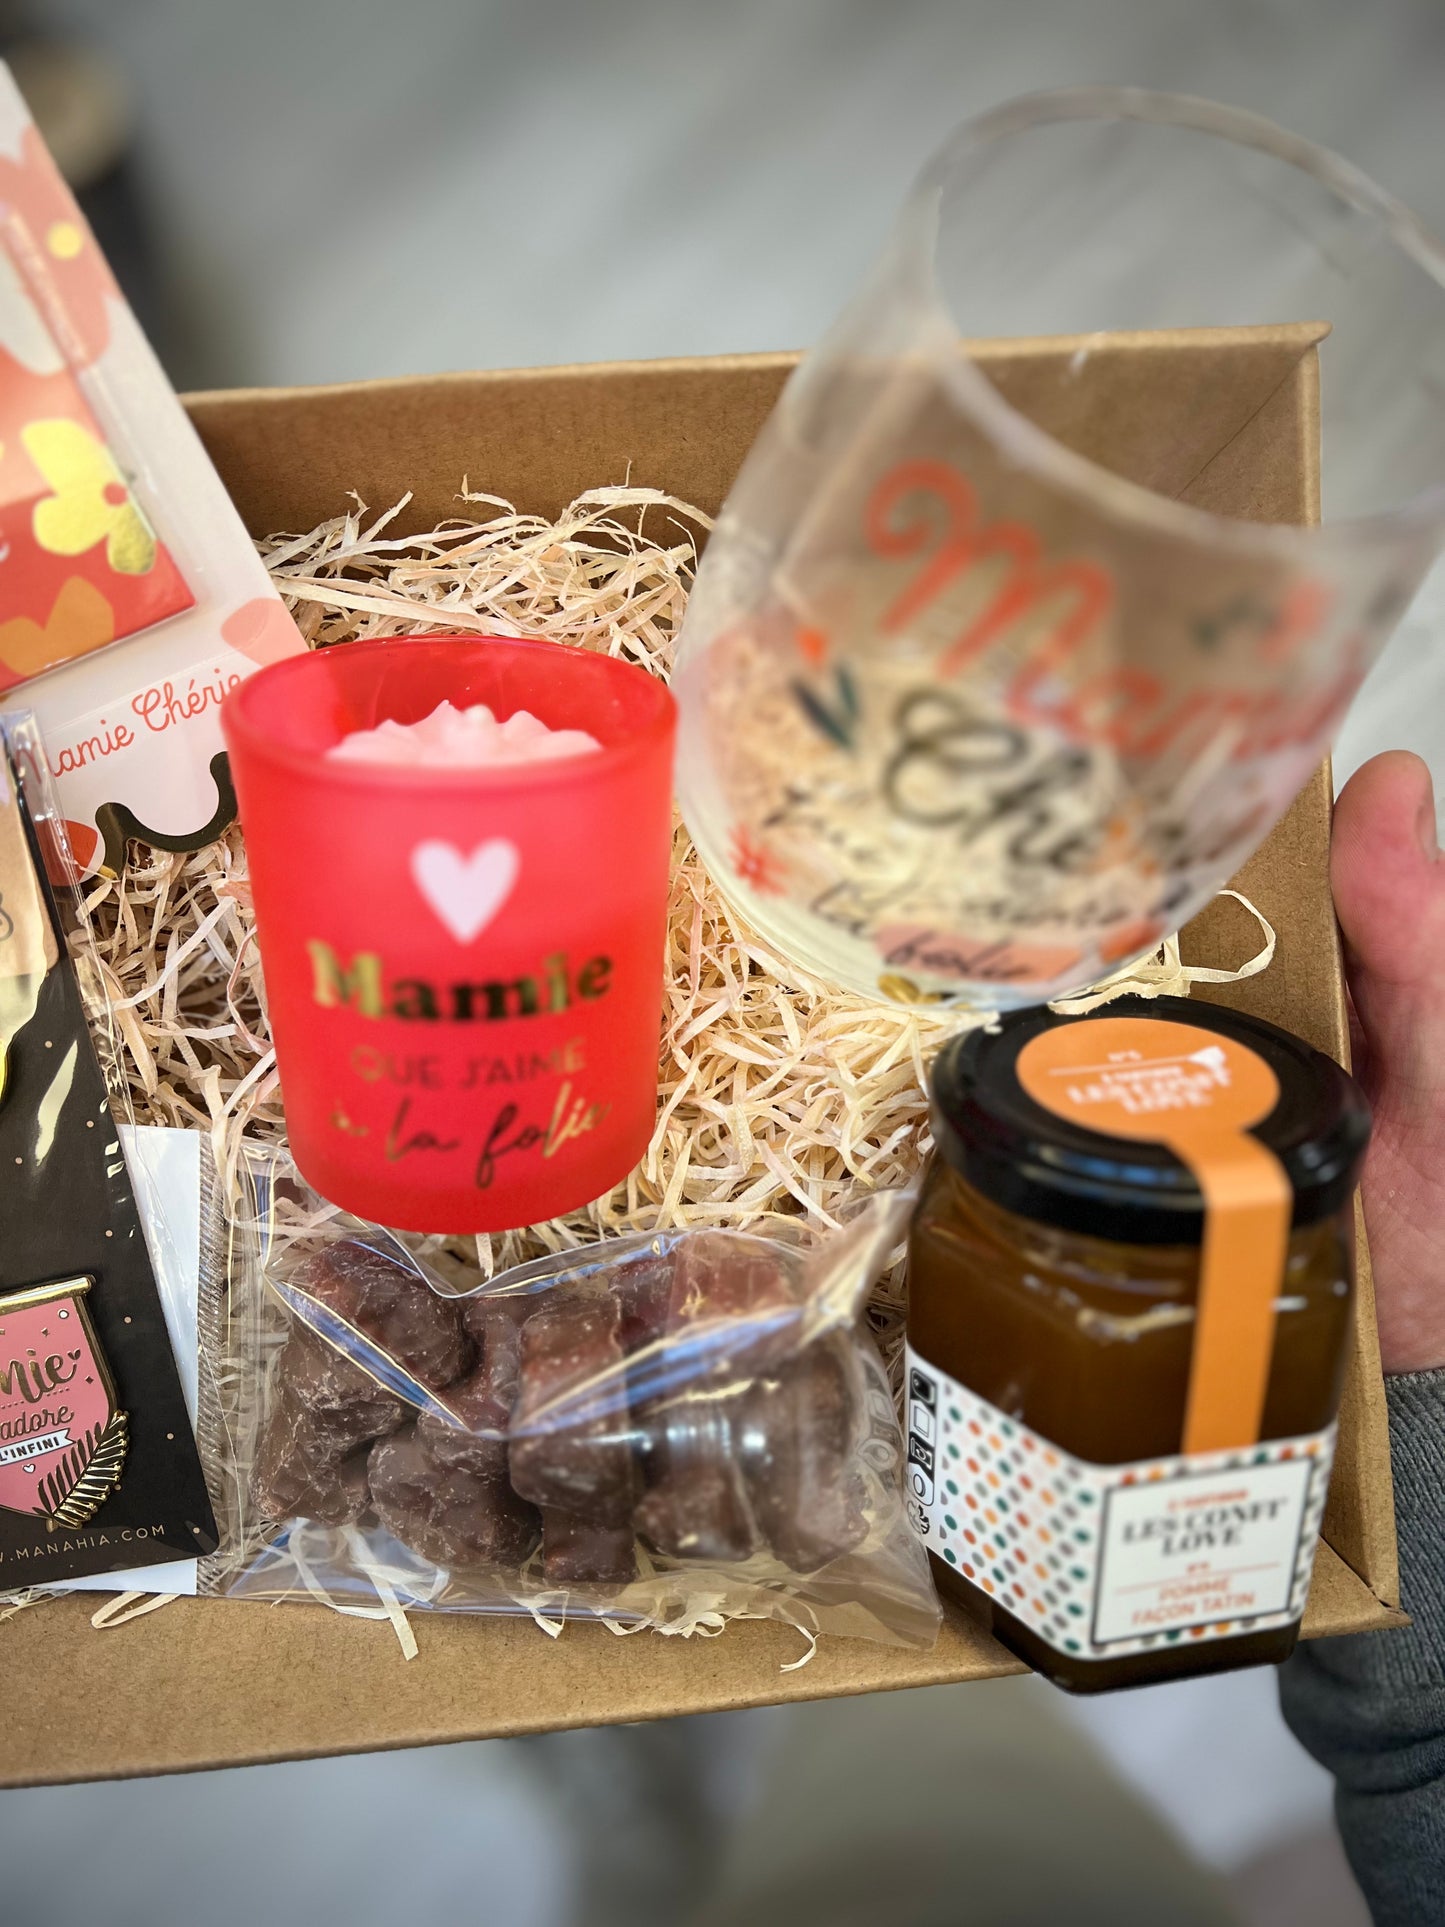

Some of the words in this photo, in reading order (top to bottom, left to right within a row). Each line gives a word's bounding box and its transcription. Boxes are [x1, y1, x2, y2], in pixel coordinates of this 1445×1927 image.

[131, 667, 242, 732] Chérie
[307, 937, 614, 1023] Mamie
[350, 1043, 443, 1090] QUE
[386, 1095, 462, 1163] la
[474, 1080, 613, 1190] folie
[1122, 1518, 1178, 1544] LES
[1162, 1528, 1240, 1556] LOVE
